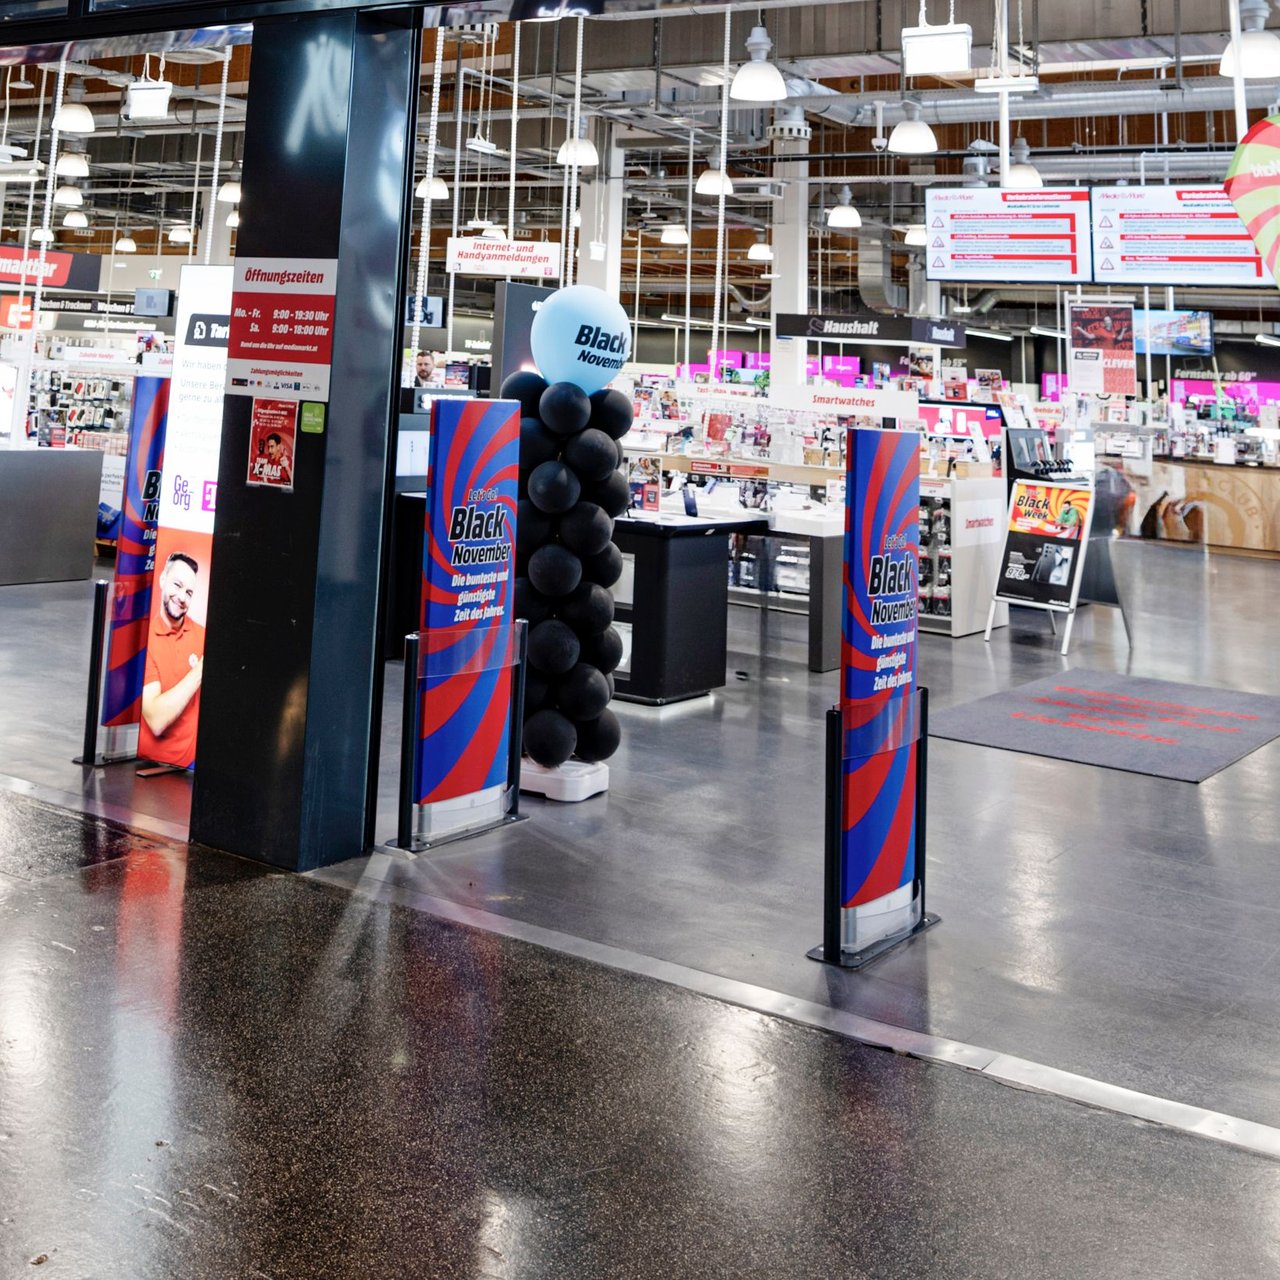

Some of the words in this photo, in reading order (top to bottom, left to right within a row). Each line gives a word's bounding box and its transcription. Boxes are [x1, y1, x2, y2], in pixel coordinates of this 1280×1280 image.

[473, 241, 515, 252] Internet-
[516, 244, 535, 253] und
[457, 250, 549, 265] Handyanmeldungen
[244, 267, 324, 285] Öffnungszeiten
[273, 309, 289, 320] 9:00
[295, 310, 315, 320] 19:30
[315, 311, 329, 321] Uhr
[272, 324, 289, 334] 9:00
[314, 325, 329, 336] Uhr
[823, 319, 879, 335] Haushalt
[575, 324, 628, 355] Black
[812, 394, 876, 408] Smartwatches
[1017, 495, 1050, 510] Black
[448, 503, 507, 542] Black
[1023, 509, 1048, 520] Week
[451, 541, 511, 567] November
[451, 575, 465, 587] Die
[465, 572, 496, 586] bunteste
[496, 569, 509, 581] und
[867, 552, 913, 597] Black
[454, 609, 470, 622] Zeit
[470, 607, 484, 621] des
[870, 594, 917, 625] November
[871, 634, 883, 650] Die
